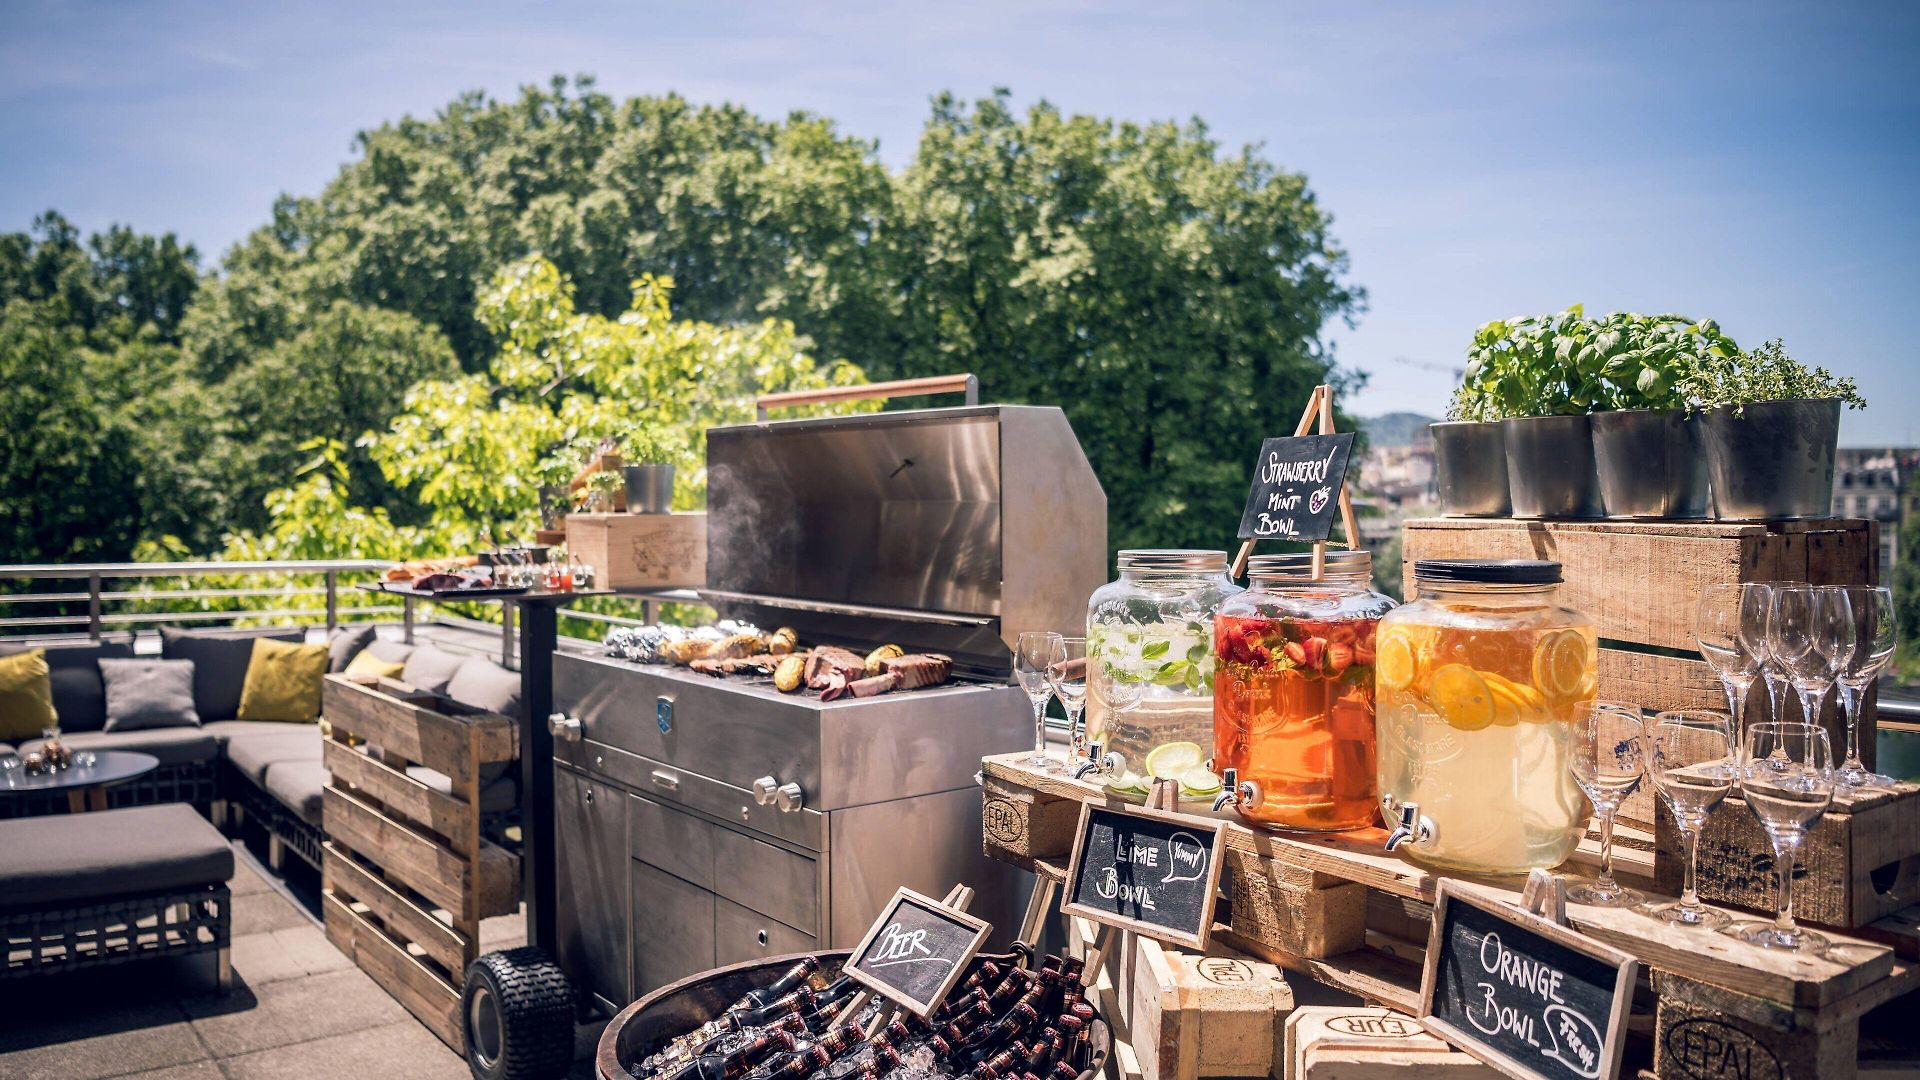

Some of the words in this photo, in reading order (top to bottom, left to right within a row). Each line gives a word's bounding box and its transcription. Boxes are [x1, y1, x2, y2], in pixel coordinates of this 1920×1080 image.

[1262, 446, 1337, 486] STRAWBERRY
[1254, 513, 1299, 536] BOWL
[1174, 841, 1200, 868] YUMMY
[1096, 866, 1156, 910] BOWL
[867, 923, 931, 963] BEER
[1480, 932, 1565, 1005] ORANGE
[1346, 1018, 1407, 1035] EUR
[1466, 982, 1540, 1048] BOWL
